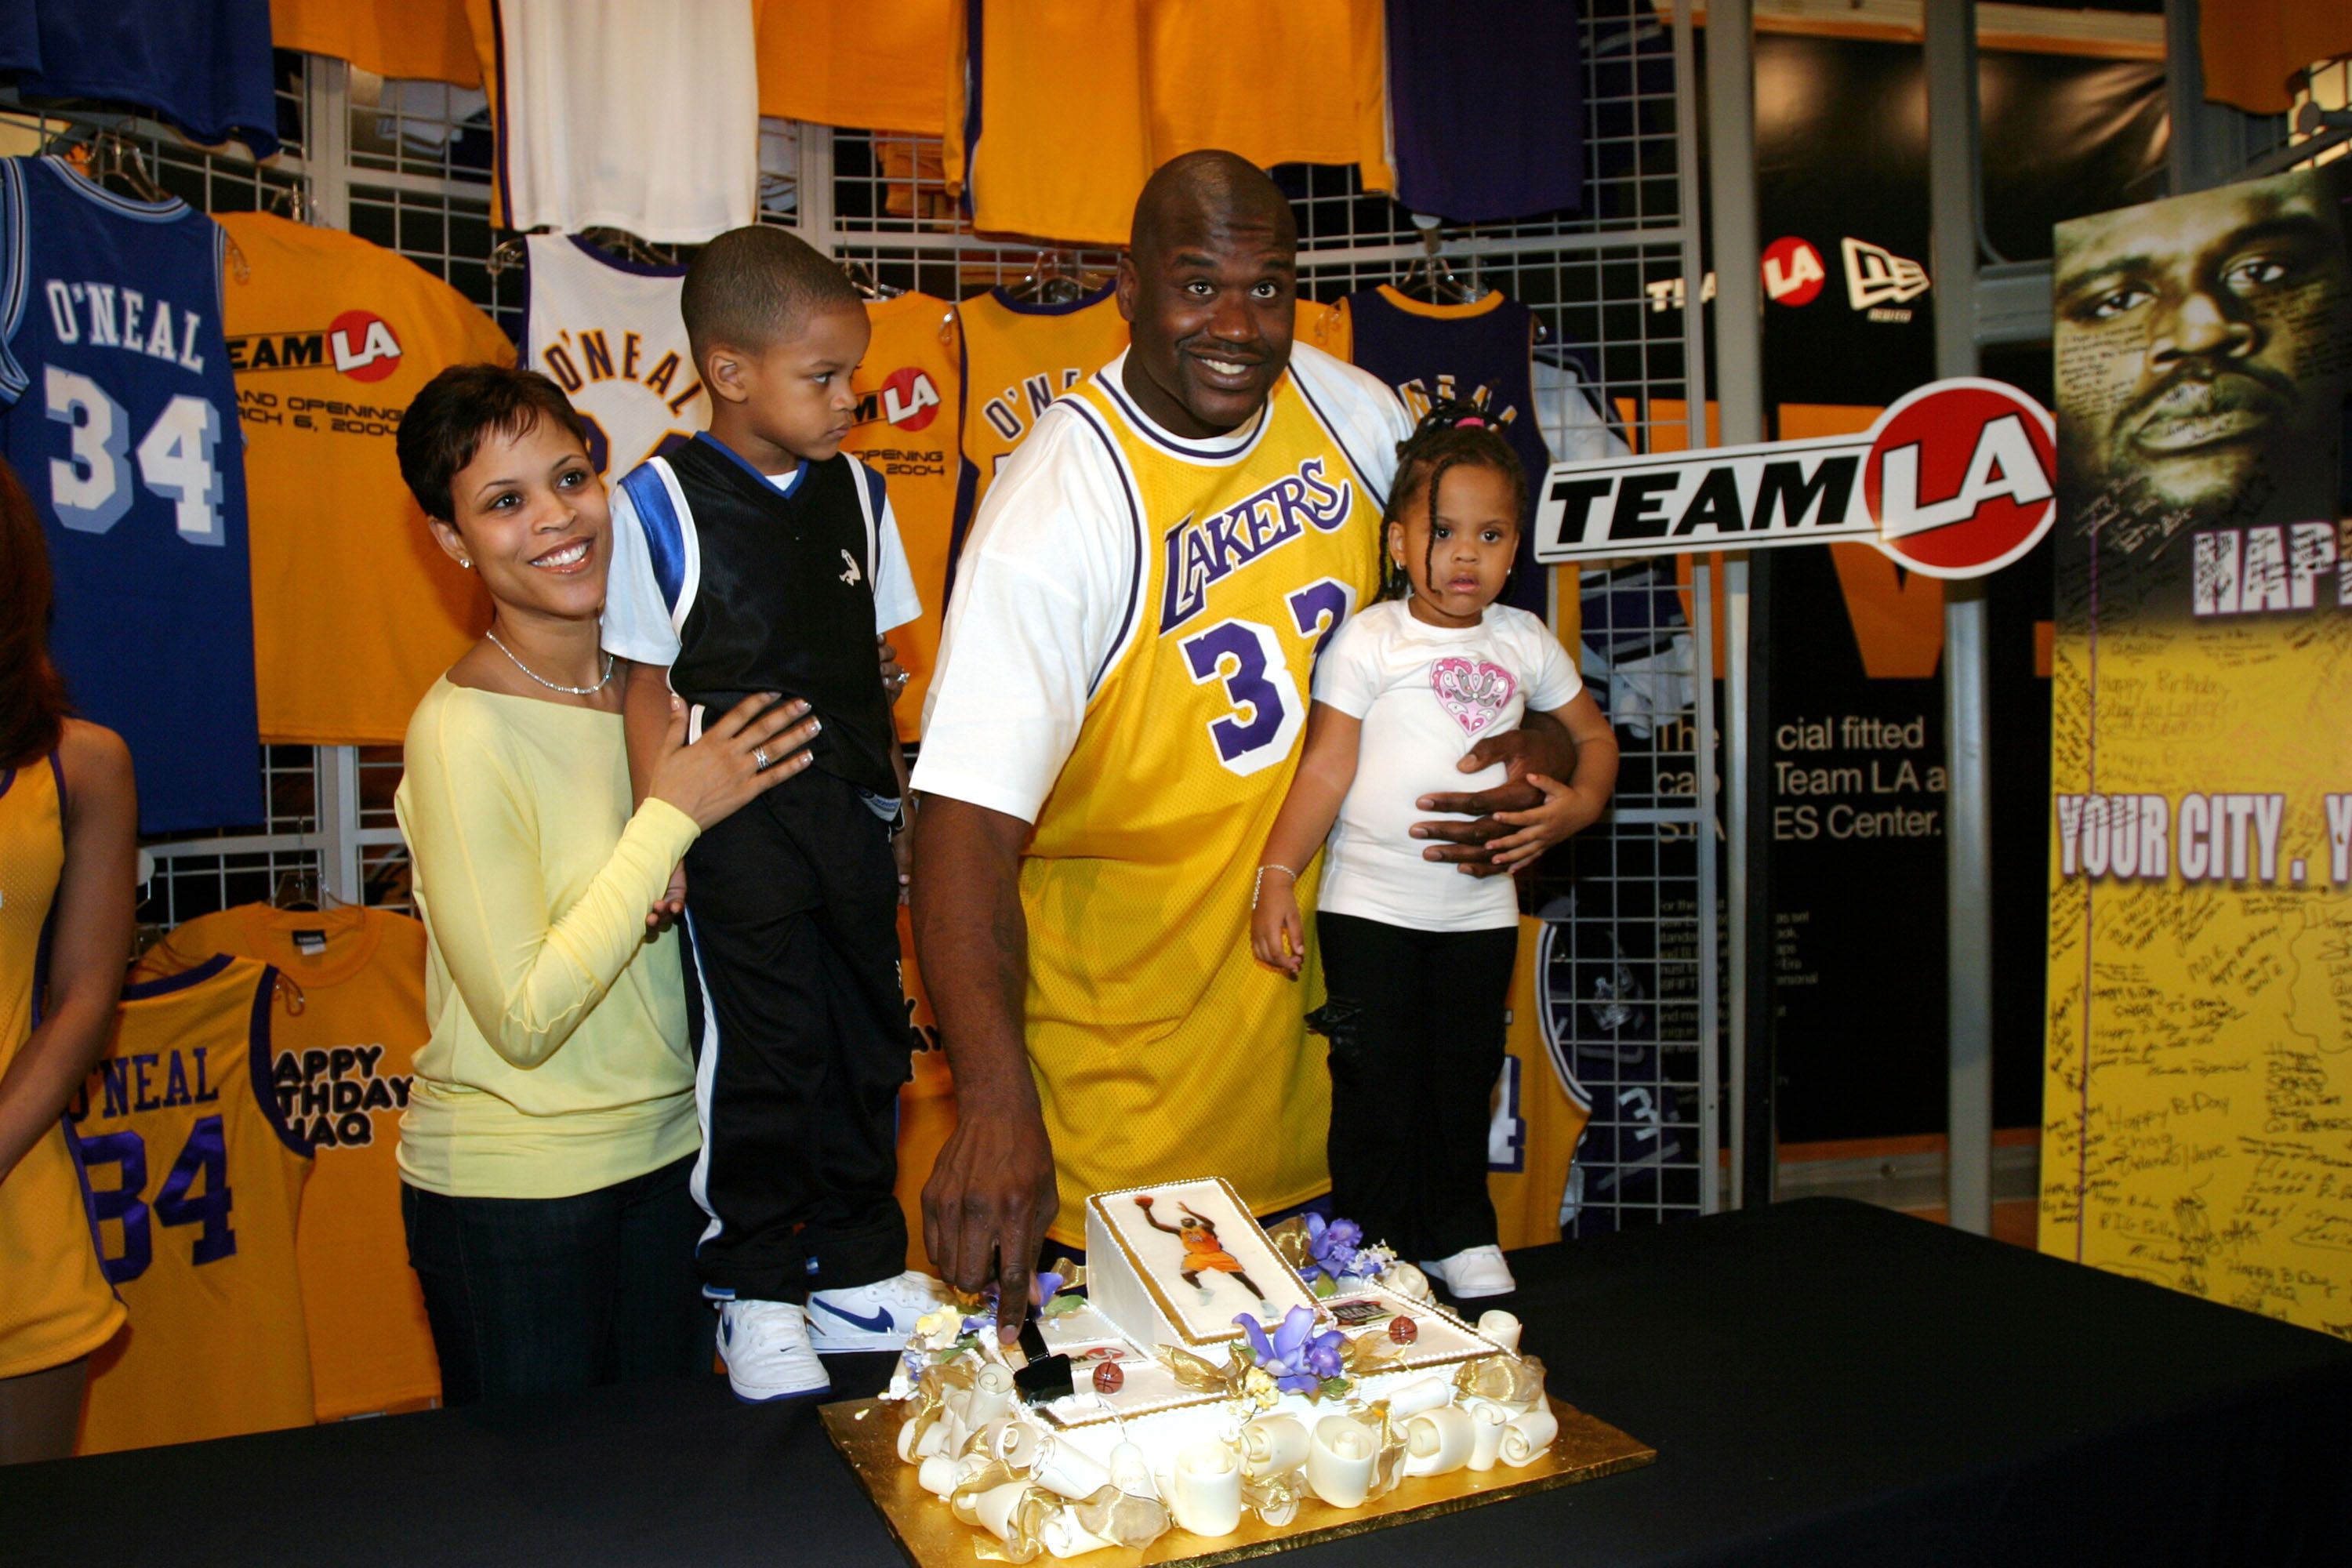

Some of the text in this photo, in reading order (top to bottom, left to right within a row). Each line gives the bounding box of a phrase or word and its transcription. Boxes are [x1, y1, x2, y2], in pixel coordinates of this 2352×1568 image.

[45, 278, 205, 376] O'NEAL
[226, 320, 402, 374] EAM LA
[542, 328, 703, 419] O'NEAL
[884, 372, 940, 425] LA
[44, 364, 227, 547] 34
[885, 463, 945, 476] 2004
[1549, 454, 1863, 546] TEAM
[1881, 412, 2056, 541] LA
[1158, 455, 1352, 638] LAKERS
[1775, 715, 1834, 752] cial
[1841, 715, 1926, 751] fitted
[1774, 760, 1863, 797] Team
[1871, 758, 1920, 794] LA
[1926, 766, 1948, 793] a
[1827, 804, 1943, 839] Center.
[2056, 793, 2171, 879] YOUR
[272, 1044, 386, 1083] APPY
[274, 1076, 415, 1118] THDAY
[292, 1112, 373, 1148] AQ
[79, 1113, 238, 1285] 34
